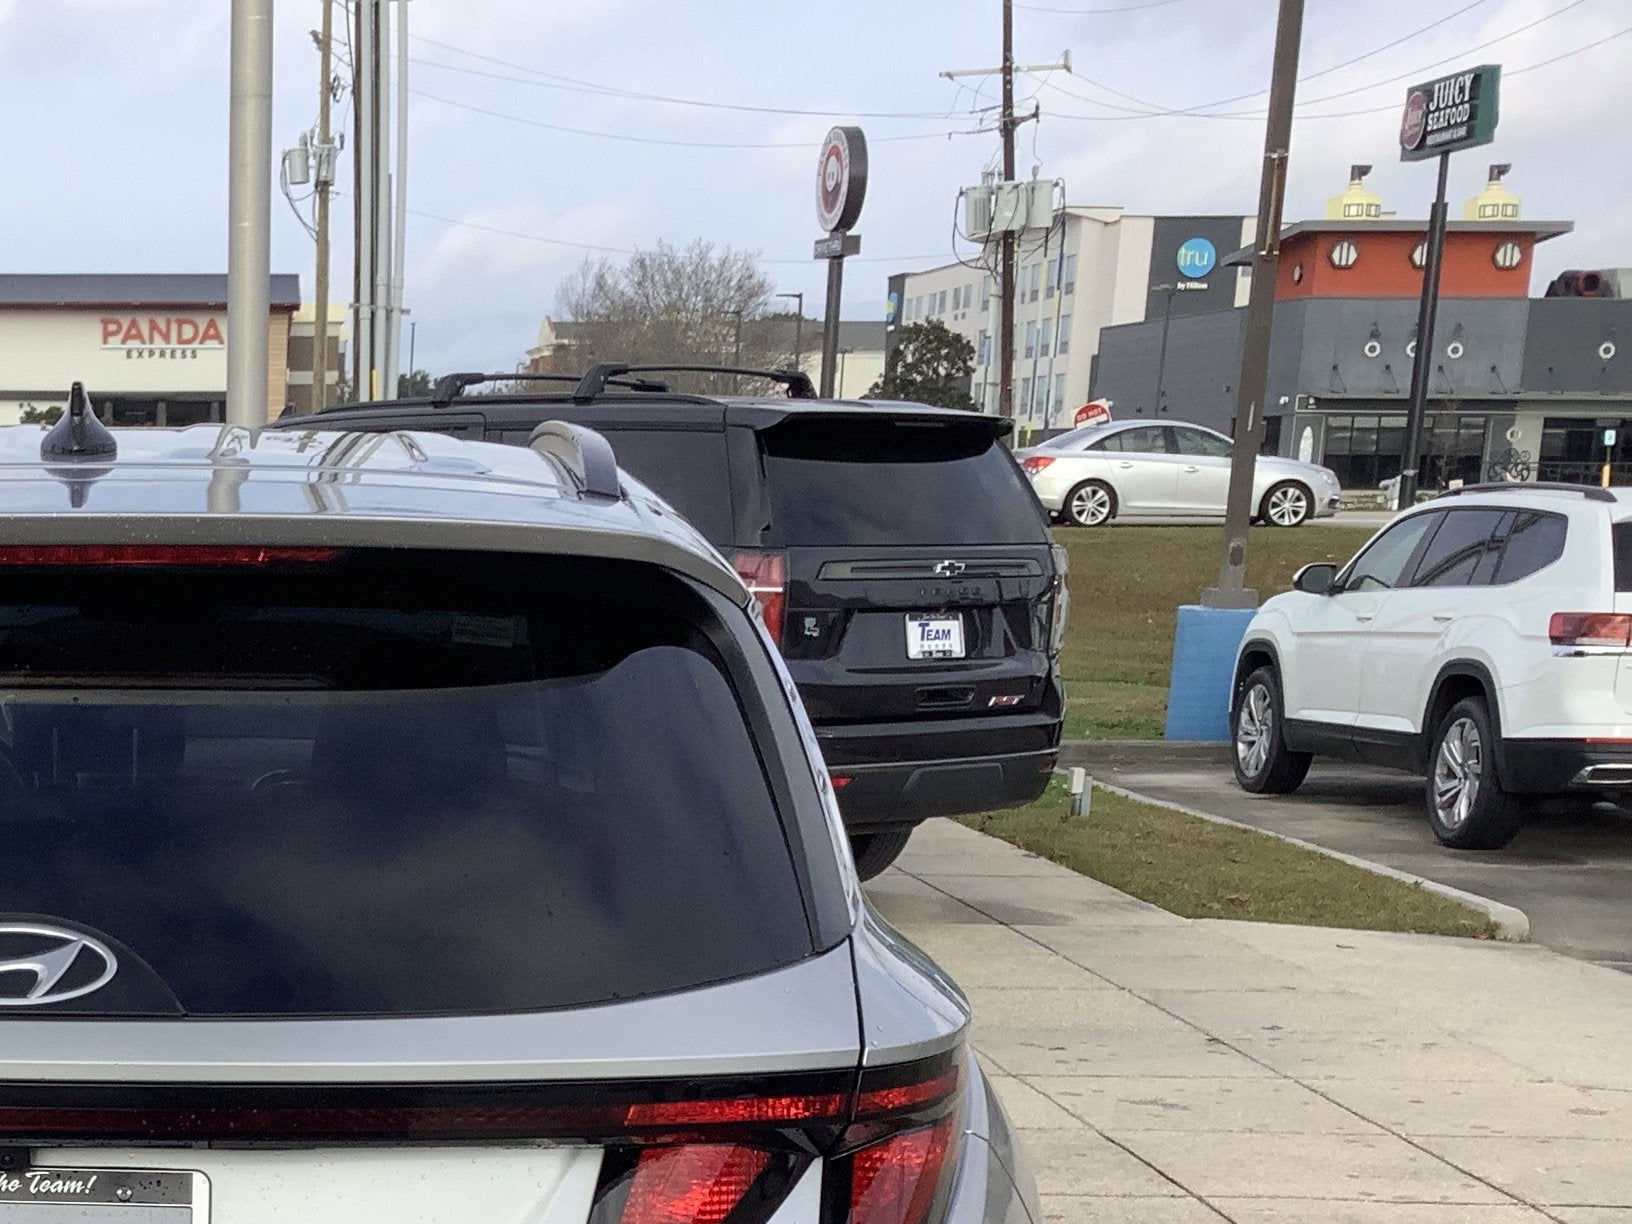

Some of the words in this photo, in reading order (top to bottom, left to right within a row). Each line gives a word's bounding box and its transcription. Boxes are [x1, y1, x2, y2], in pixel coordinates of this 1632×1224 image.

[1429, 73, 1475, 111] JUICY
[1427, 103, 1471, 132] SEAFOOD
[1177, 247, 1209, 267] tru
[100, 318, 225, 345] PANDA
[126, 349, 198, 360] EXPRESS
[918, 622, 951, 641] TEAM
[24, 1171, 98, 1195] Team!
